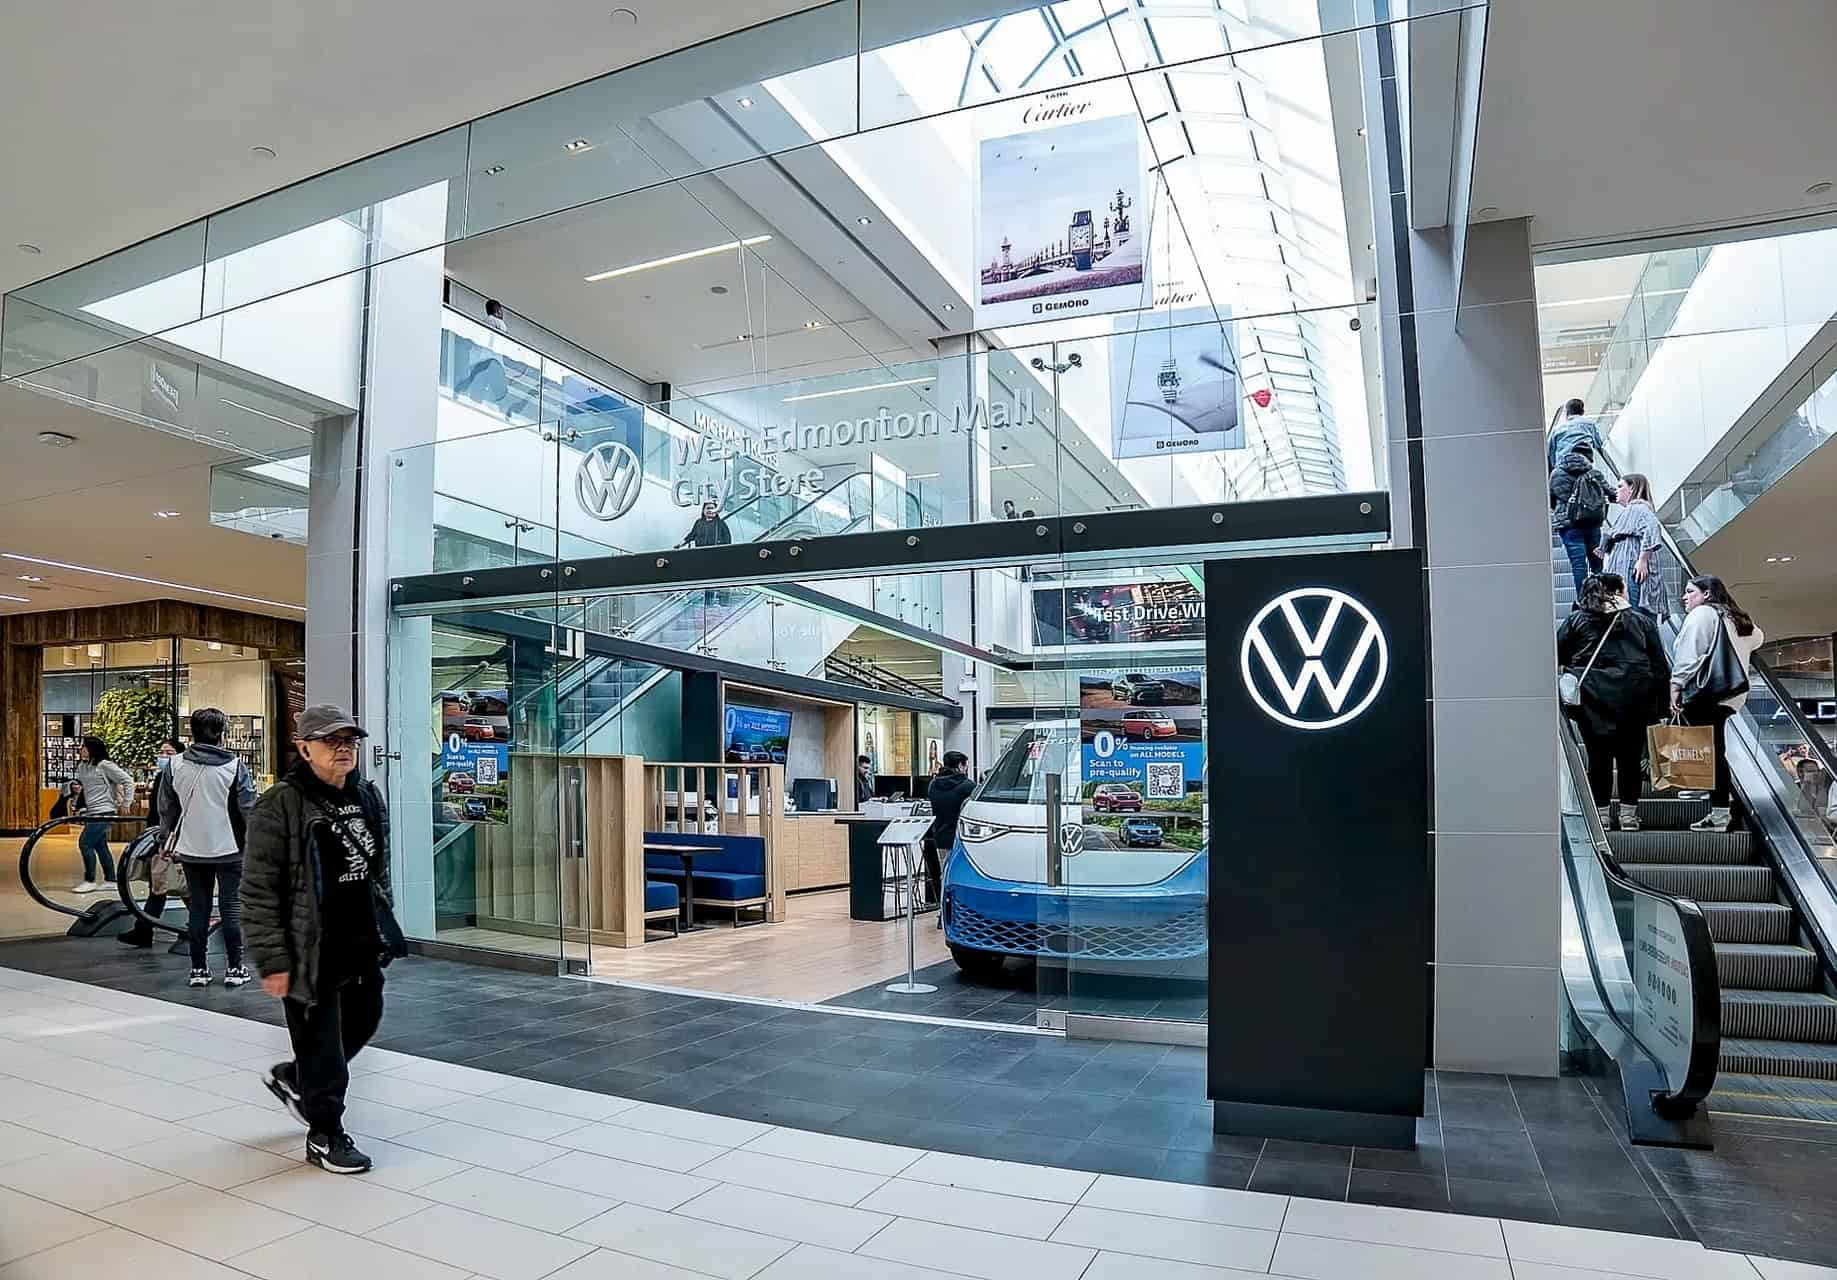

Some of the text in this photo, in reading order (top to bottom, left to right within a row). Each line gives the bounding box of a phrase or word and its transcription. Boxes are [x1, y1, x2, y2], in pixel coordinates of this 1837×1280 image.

[1022, 102, 1091, 124] Cartier
[1154, 292, 1197, 306] artier
[676, 387, 1036, 465] West Edmonton Mall
[672, 466, 825, 514] City Store
[1094, 606, 1131, 623] Test
[1134, 604, 1178, 620] Drive
[1241, 587, 1388, 729] VW
[1094, 731, 1128, 757] 0%
[1089, 767, 1142, 778] pre-qualify
[1090, 759, 1124, 767] Scan to
